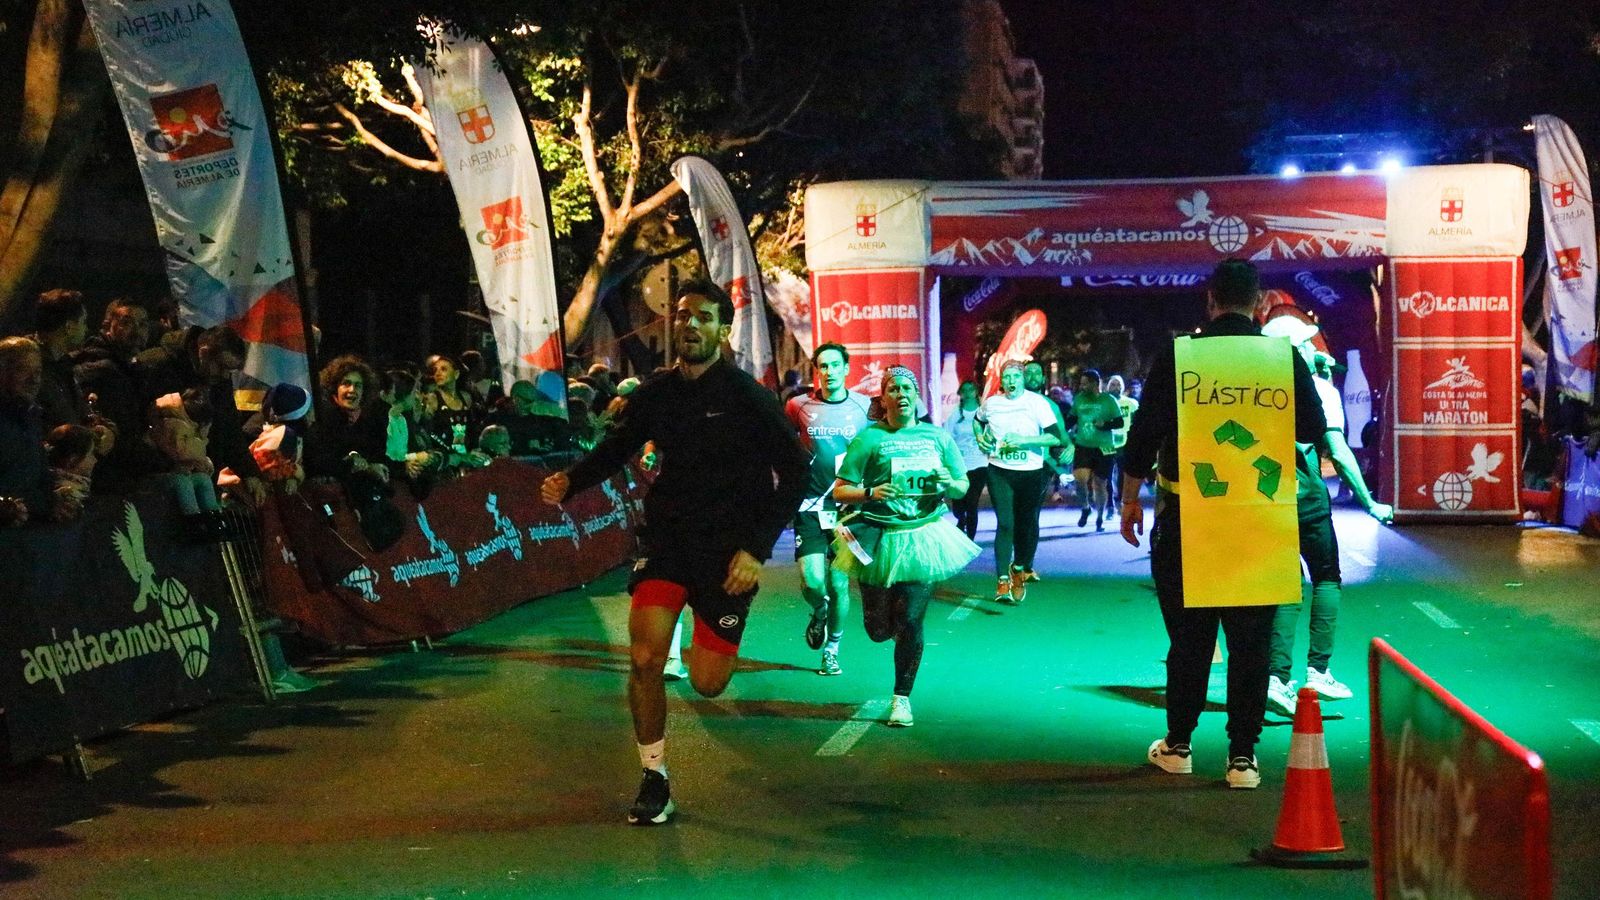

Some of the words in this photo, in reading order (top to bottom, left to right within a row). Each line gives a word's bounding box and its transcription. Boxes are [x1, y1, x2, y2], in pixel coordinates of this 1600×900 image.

[1051, 227, 1206, 248] aquéatacamos
[821, 301, 919, 327] VOLCANICA
[1398, 291, 1509, 318] VOLCANICA
